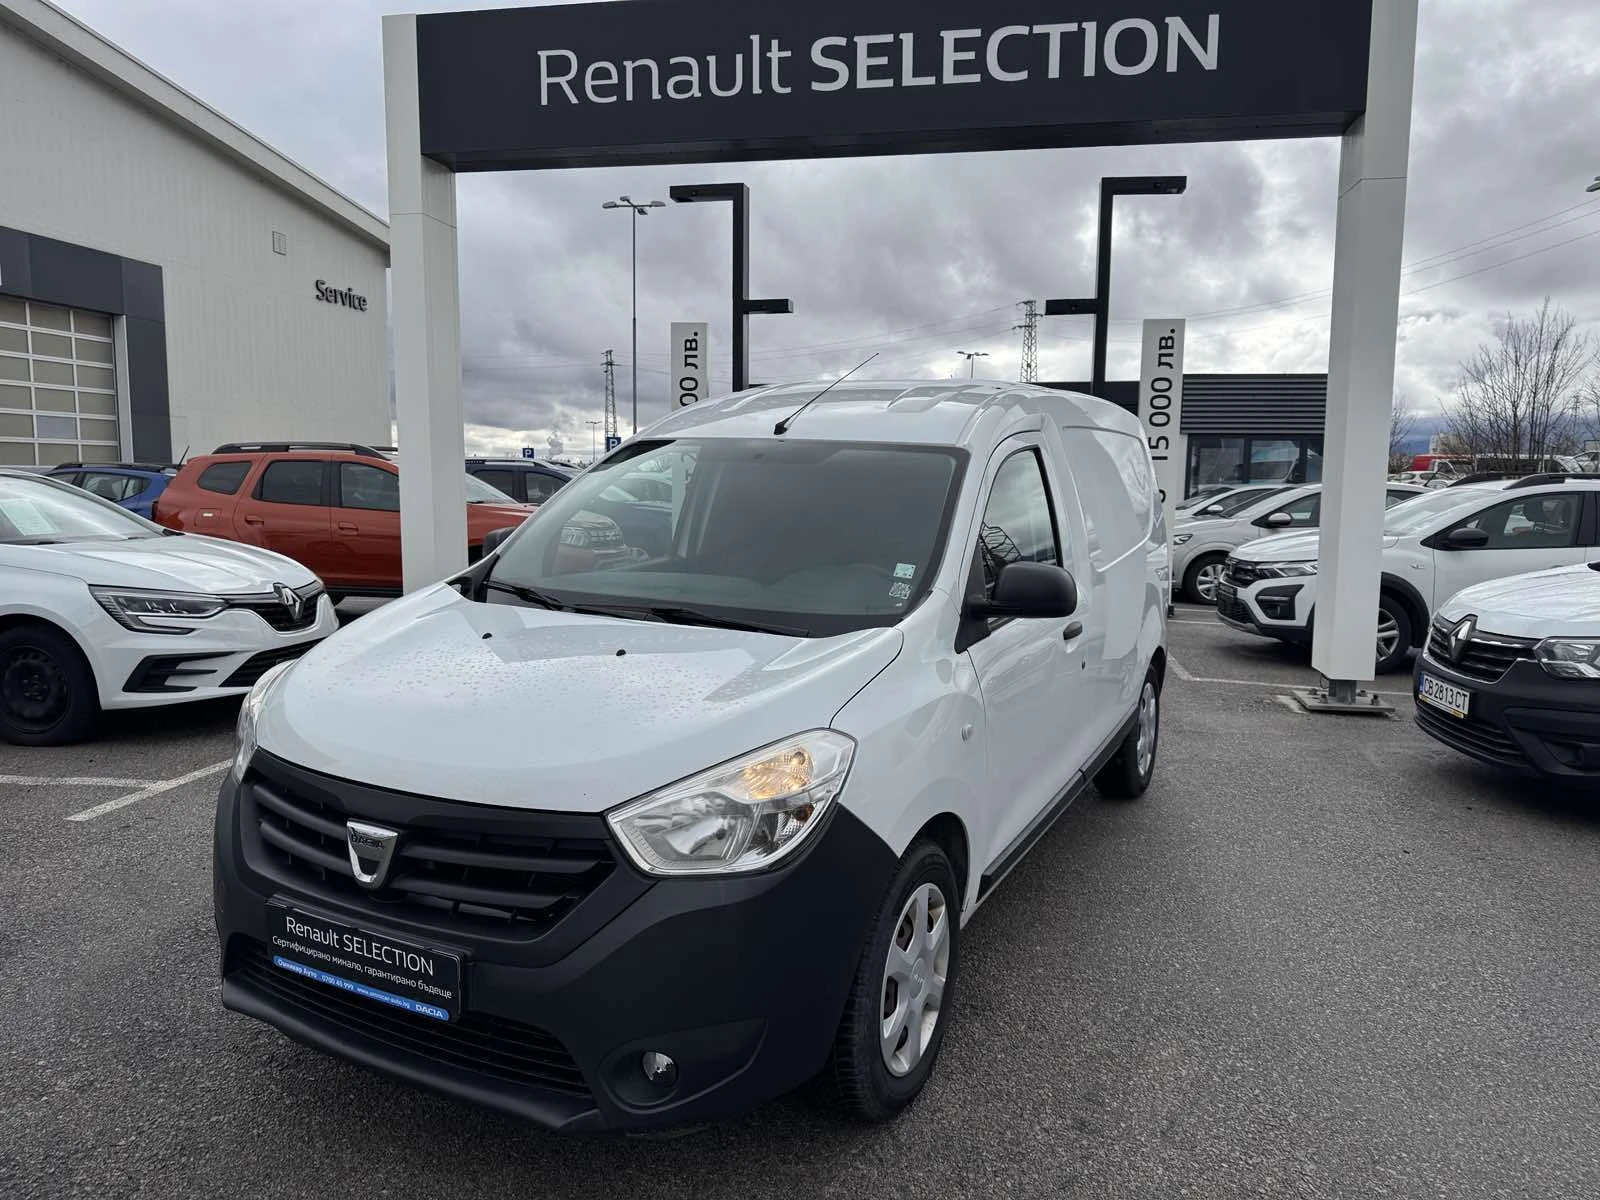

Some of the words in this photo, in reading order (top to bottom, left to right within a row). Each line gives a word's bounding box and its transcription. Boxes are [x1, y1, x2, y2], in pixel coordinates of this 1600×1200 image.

[536, 34, 792, 105] Renault
[810, 14, 1220, 92] SELECTION
[315, 279, 368, 312] Service
[684, 331, 699, 370] лв.
[1158, 328, 1176, 369] лв.
[1149, 377, 1173, 427] 000
[524, 448, 532, 459] P
[609, 438, 618, 450] P
[286, 916, 340, 949] Renault
[343, 934, 434, 977] SELECTION
[272, 935, 331, 962] Сертифицирано
[332, 956, 364, 973] минало,
[364, 965, 417, 988] гарантирано
[418, 980, 452, 999] бъдеще
[415, 1003, 444, 1019] DACIA
